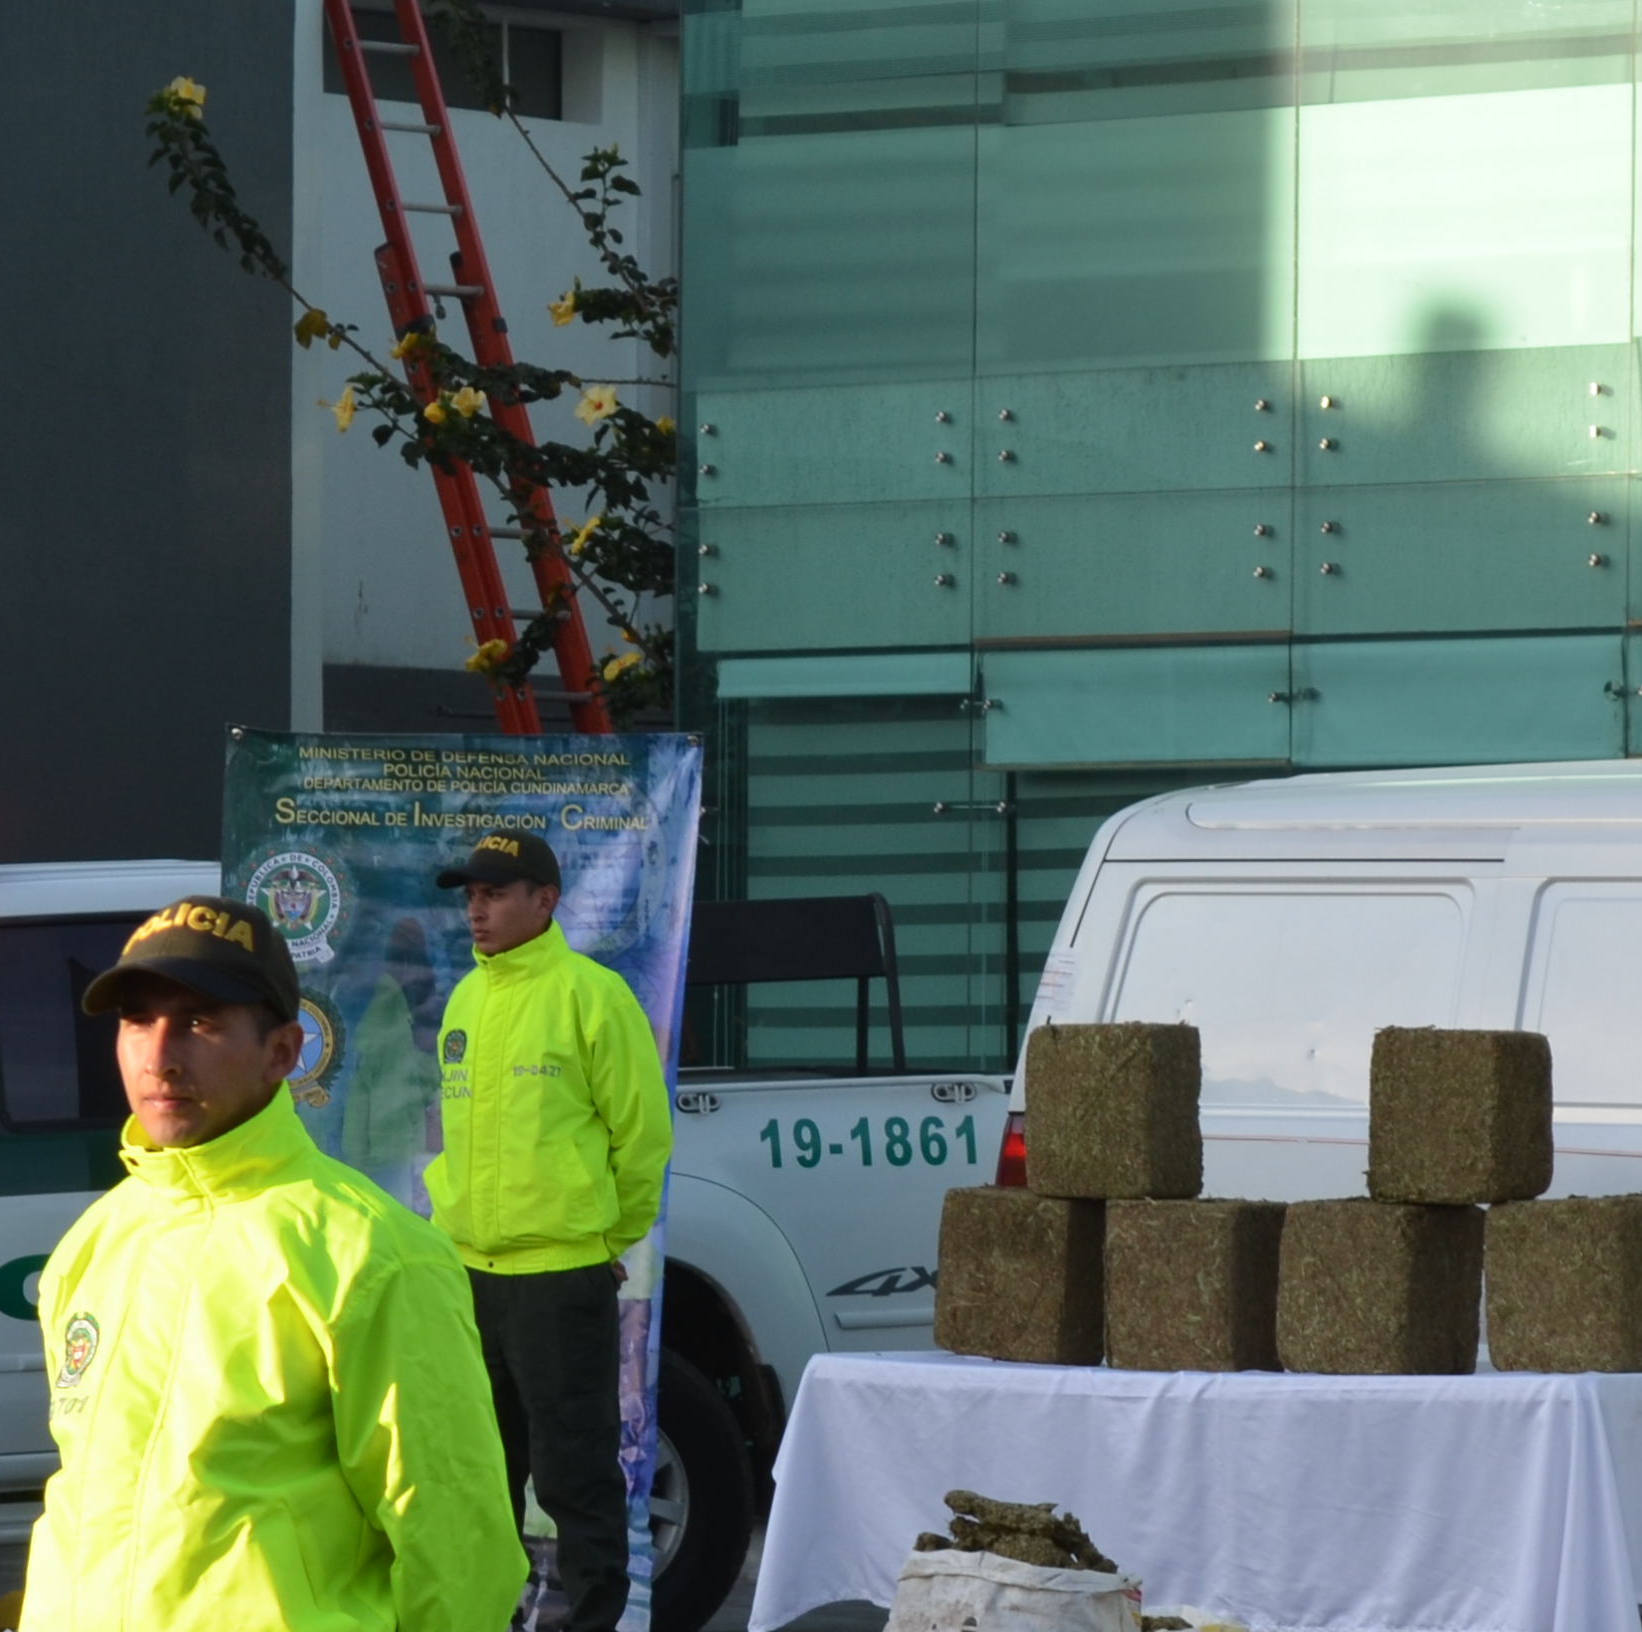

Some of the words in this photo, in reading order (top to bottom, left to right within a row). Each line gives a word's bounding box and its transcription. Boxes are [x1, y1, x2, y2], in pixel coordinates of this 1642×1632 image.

[299, 747, 406, 761] MINISTERIO
[411, 750, 436, 762] DE
[442, 751, 528, 765] DEFENSA
[533, 754, 630, 766] NACIONAL
[383, 763, 452, 778] POLICÍA
[457, 766, 547, 781] NACIONAL
[304, 777, 423, 792] DEPARTAMENTO
[427, 780, 447, 792] DE
[451, 780, 507, 794] POLICÍA
[511, 782, 630, 795] CUNDINAMARCA
[385, 812, 407, 826] DE
[312, 861, 338, 909] COLOMBIA
[292, 920, 332, 947] NACIONAL
[759, 1115, 978, 1168] 19-1861
